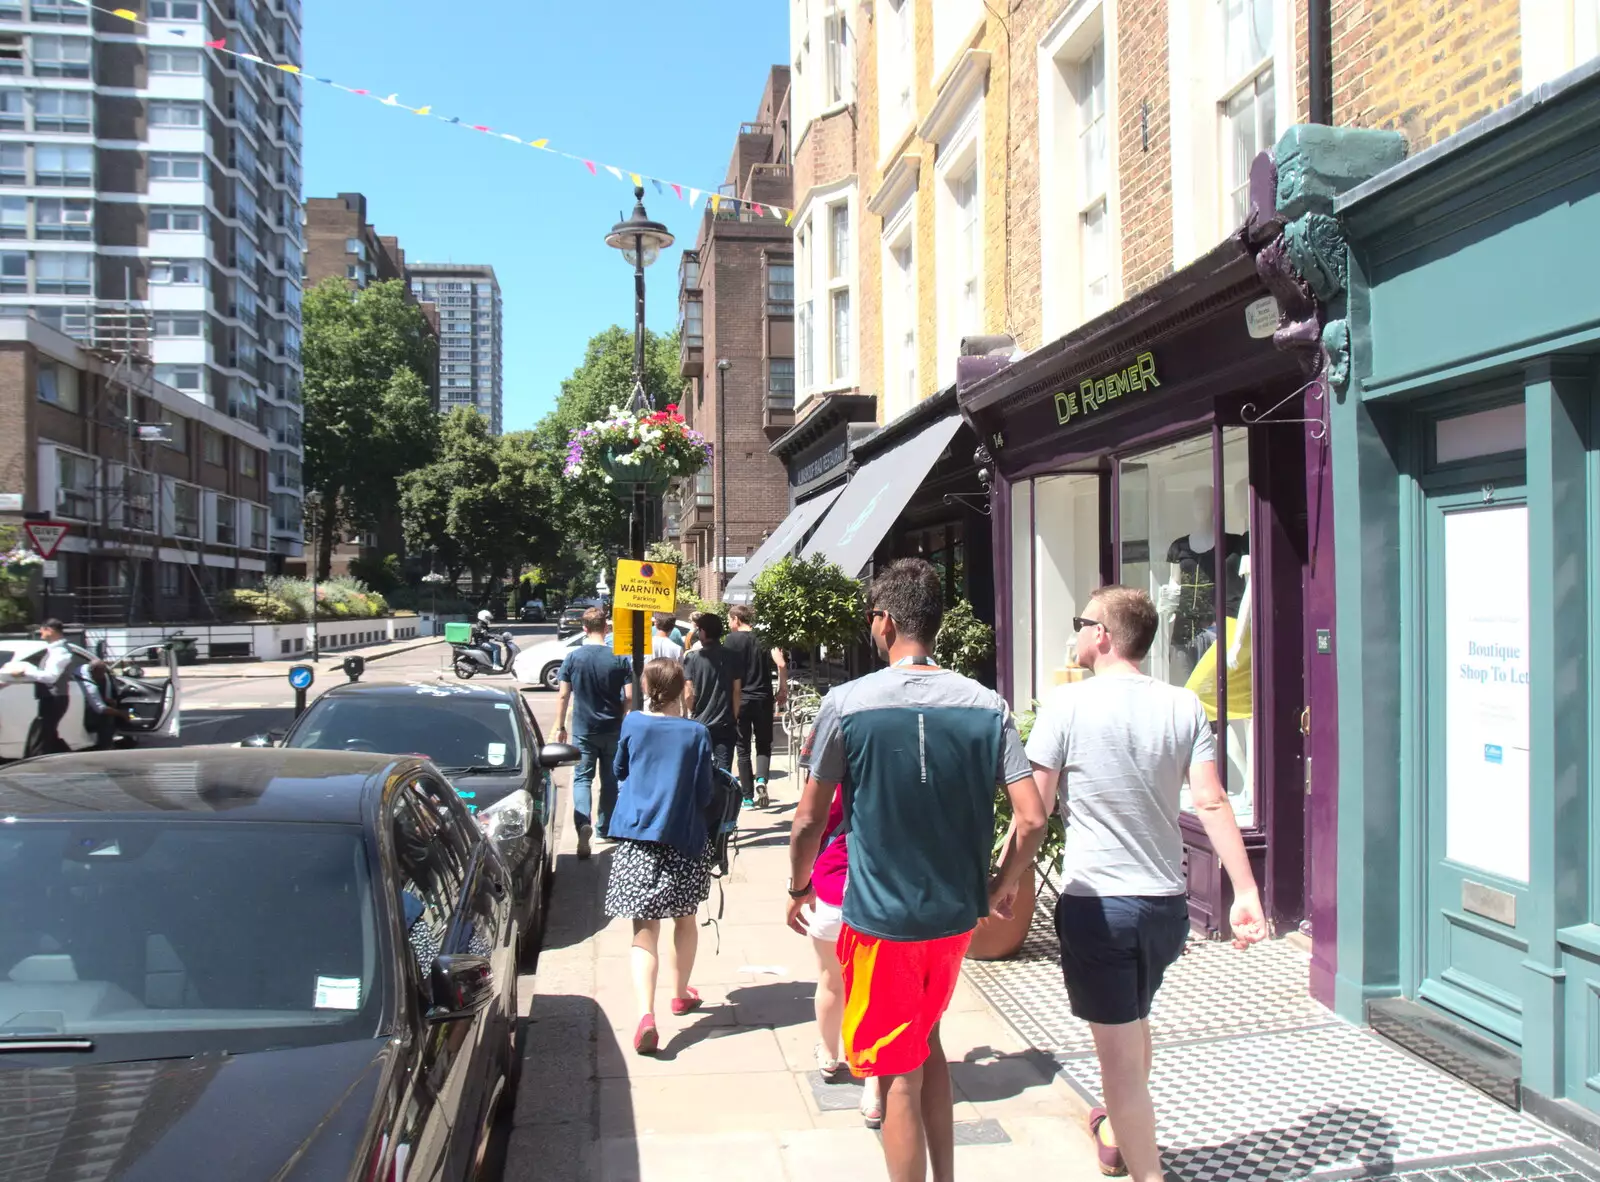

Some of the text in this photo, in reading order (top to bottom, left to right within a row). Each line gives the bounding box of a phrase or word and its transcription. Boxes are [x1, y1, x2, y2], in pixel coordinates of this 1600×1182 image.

[992, 431, 1004, 449] 14
[33, 526, 61, 535] GIVE
[620, 584, 671, 596] WARNING
[633, 595, 657, 603] Parking
[626, 602, 662, 610] suspension
[1468, 640, 1521, 662] Boutique
[1459, 663, 1530, 685] Shop To Let
